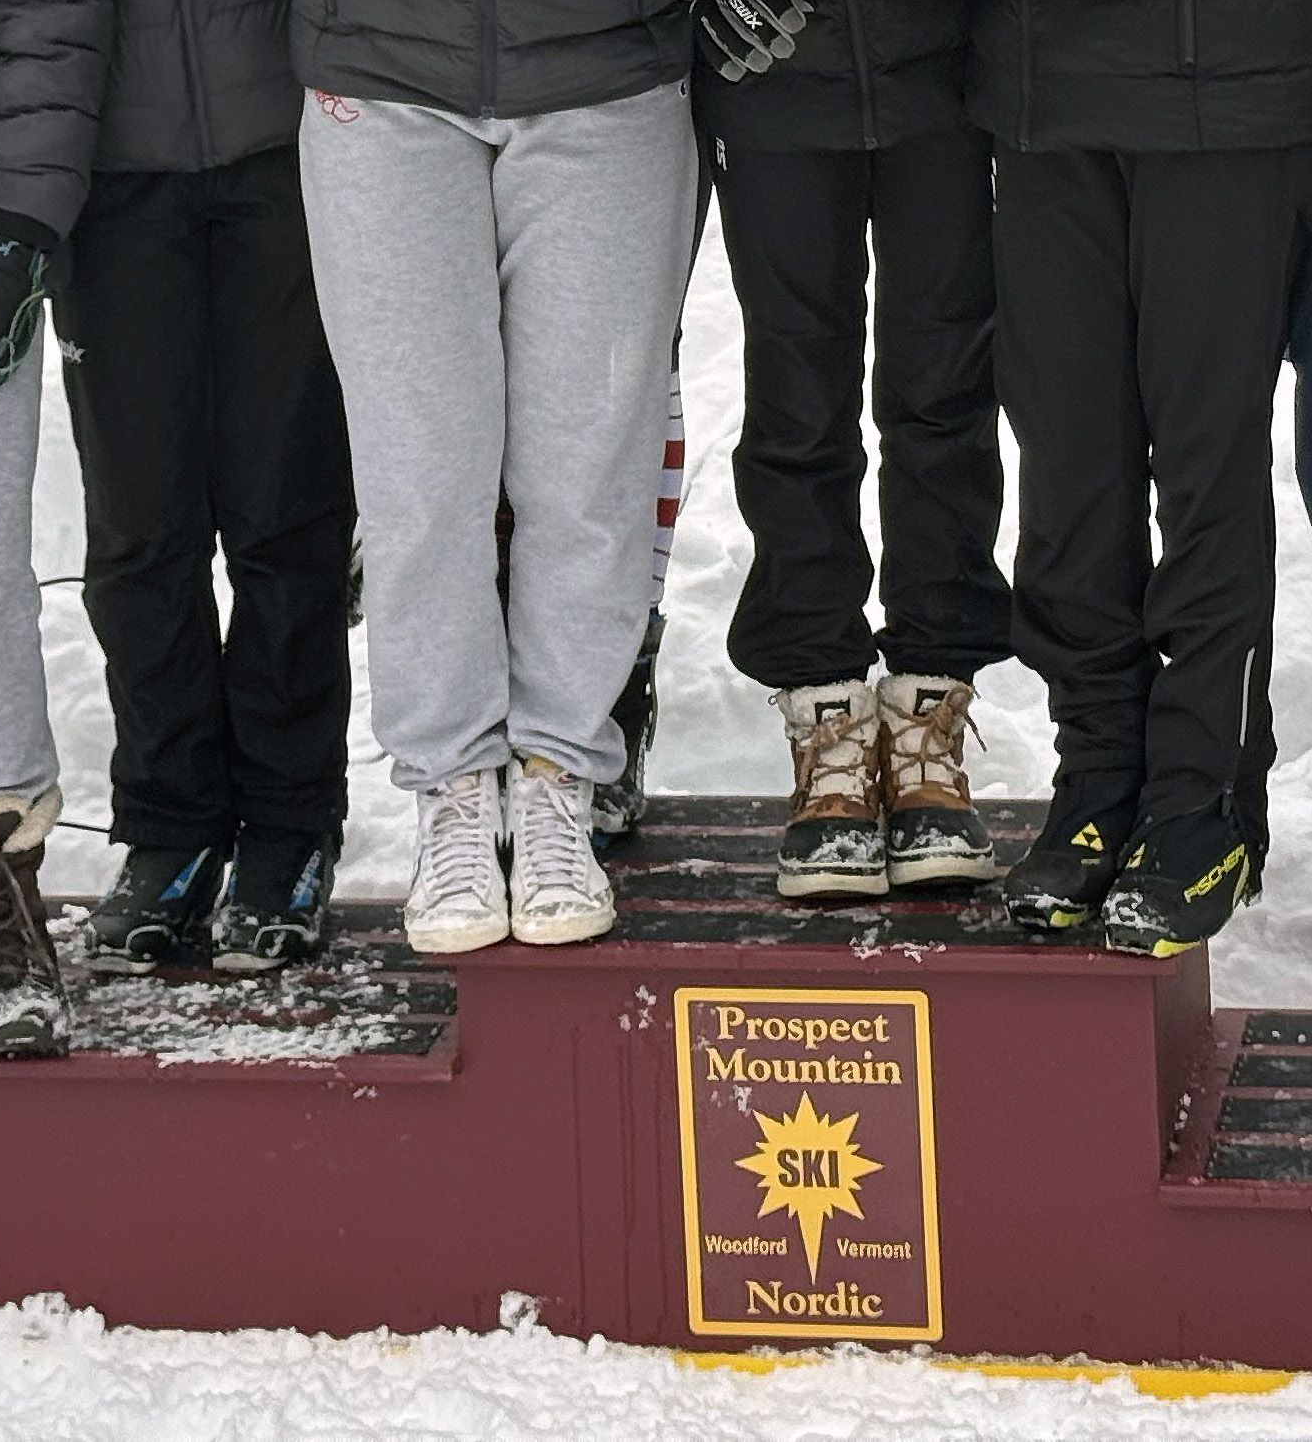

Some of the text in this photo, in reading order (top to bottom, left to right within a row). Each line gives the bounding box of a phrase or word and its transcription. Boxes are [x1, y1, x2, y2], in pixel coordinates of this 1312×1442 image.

[1183, 843, 1245, 904] FISCHER
[715, 1006, 891, 1050] Prospect
[705, 1047, 903, 1086] Mountain
[777, 1148, 840, 1189] SKI
[704, 1234, 913, 1260] Woodford Vermont
[744, 1279, 884, 1319] Nordic
